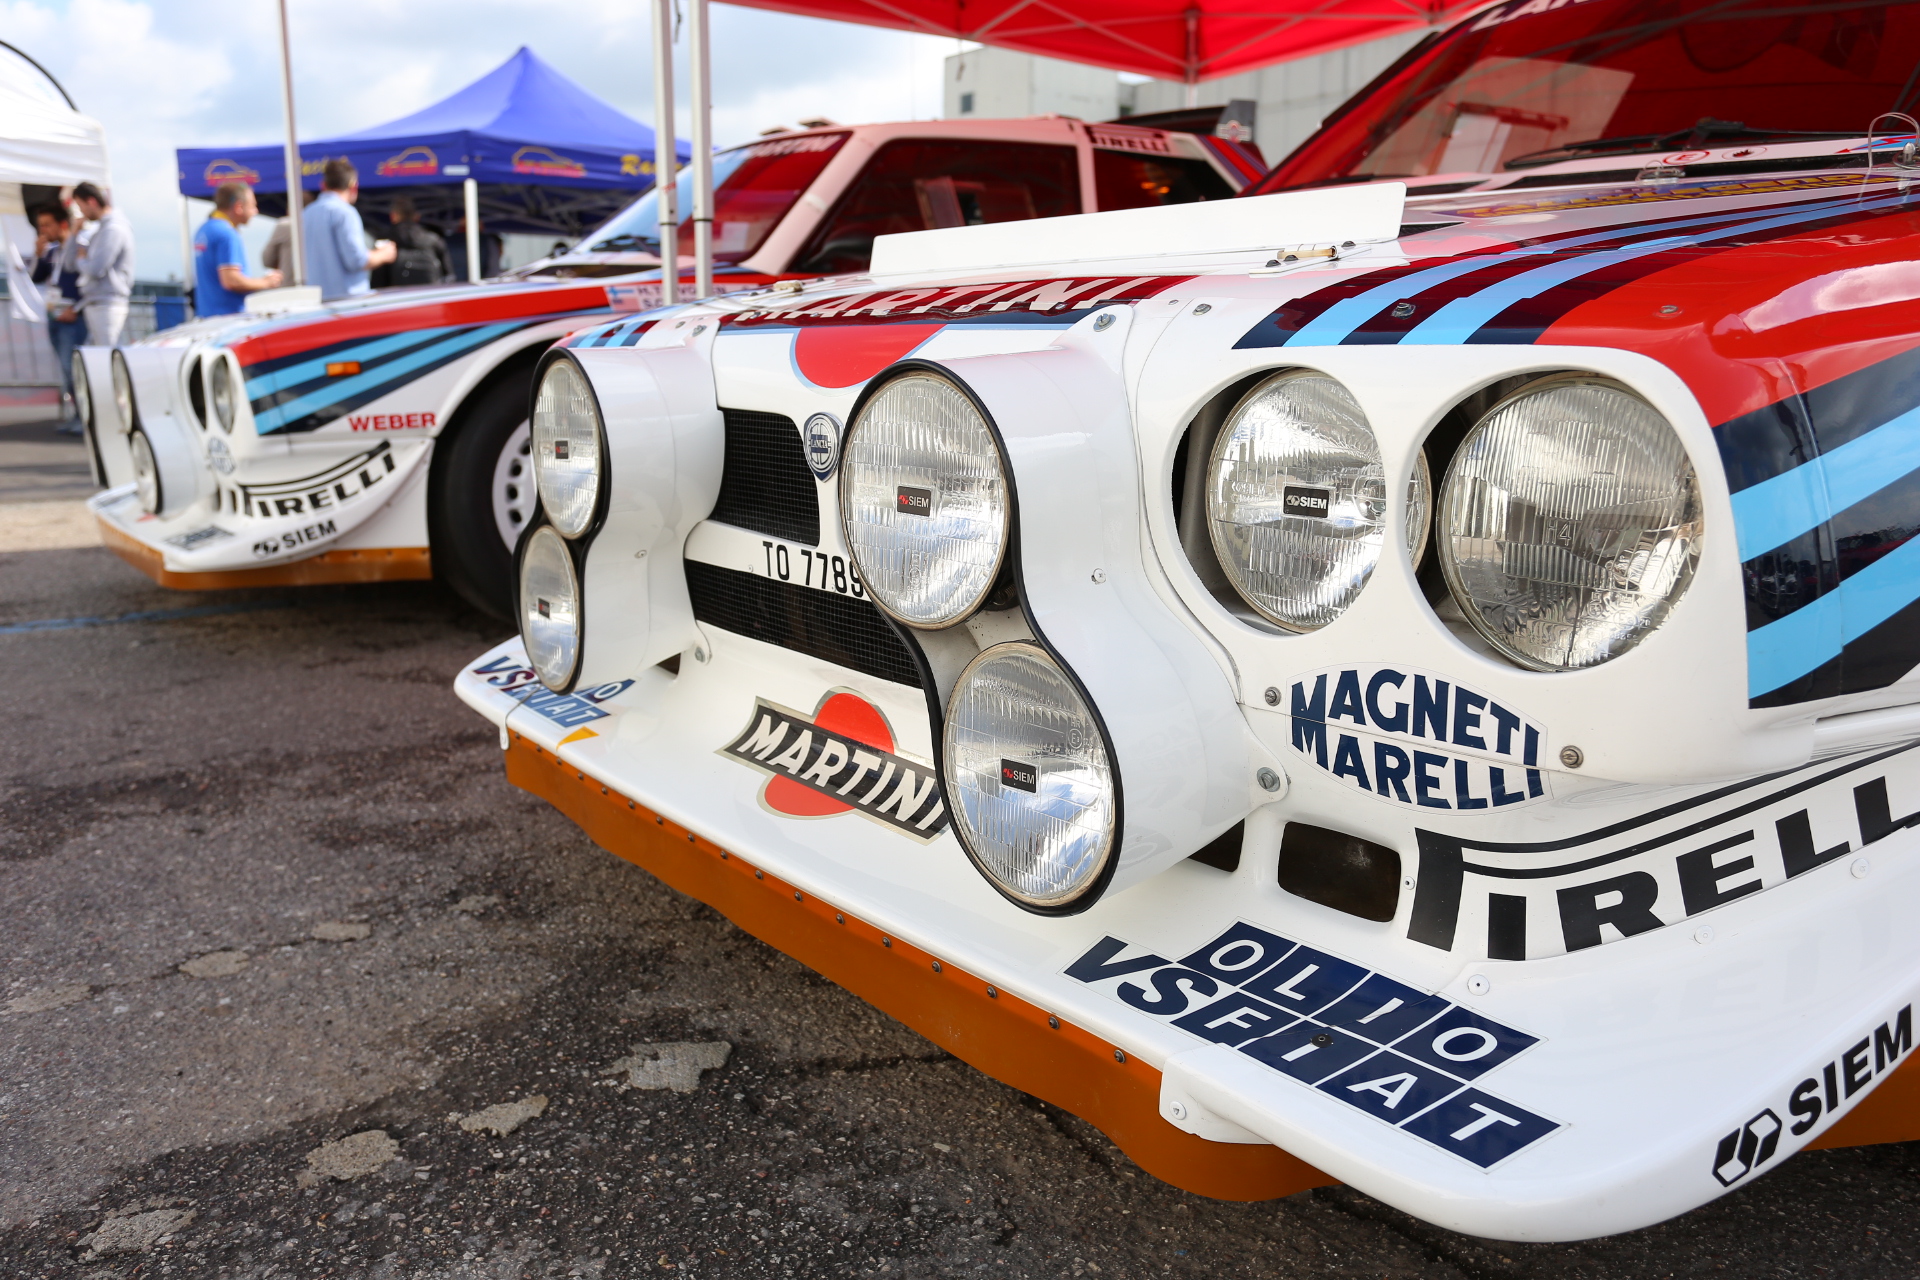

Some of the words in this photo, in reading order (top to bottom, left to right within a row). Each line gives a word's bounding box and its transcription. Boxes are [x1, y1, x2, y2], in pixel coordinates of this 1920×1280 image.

[1083, 124, 1170, 153] PIRELLI
[735, 276, 1155, 322] MARTINI
[349, 412, 437, 432] WEBER
[236, 438, 395, 518] PIRELLI
[908, 495, 929, 508] SIEM
[1300, 498, 1327, 510] SIEM
[282, 520, 337, 548] SIEM
[762, 541, 789, 580] TO
[801, 549, 864, 598] 7789
[1291, 668, 1540, 767] MAGNETI
[736, 713, 945, 832] MARTINI
[1013, 769, 1035, 785] SIEM
[1291, 719, 1545, 810] MARELLI
[1207, 938, 1500, 1063] OLIO
[1203, 1005, 1522, 1143] FIAT
[1788, 1002, 1912, 1136] SIEM
